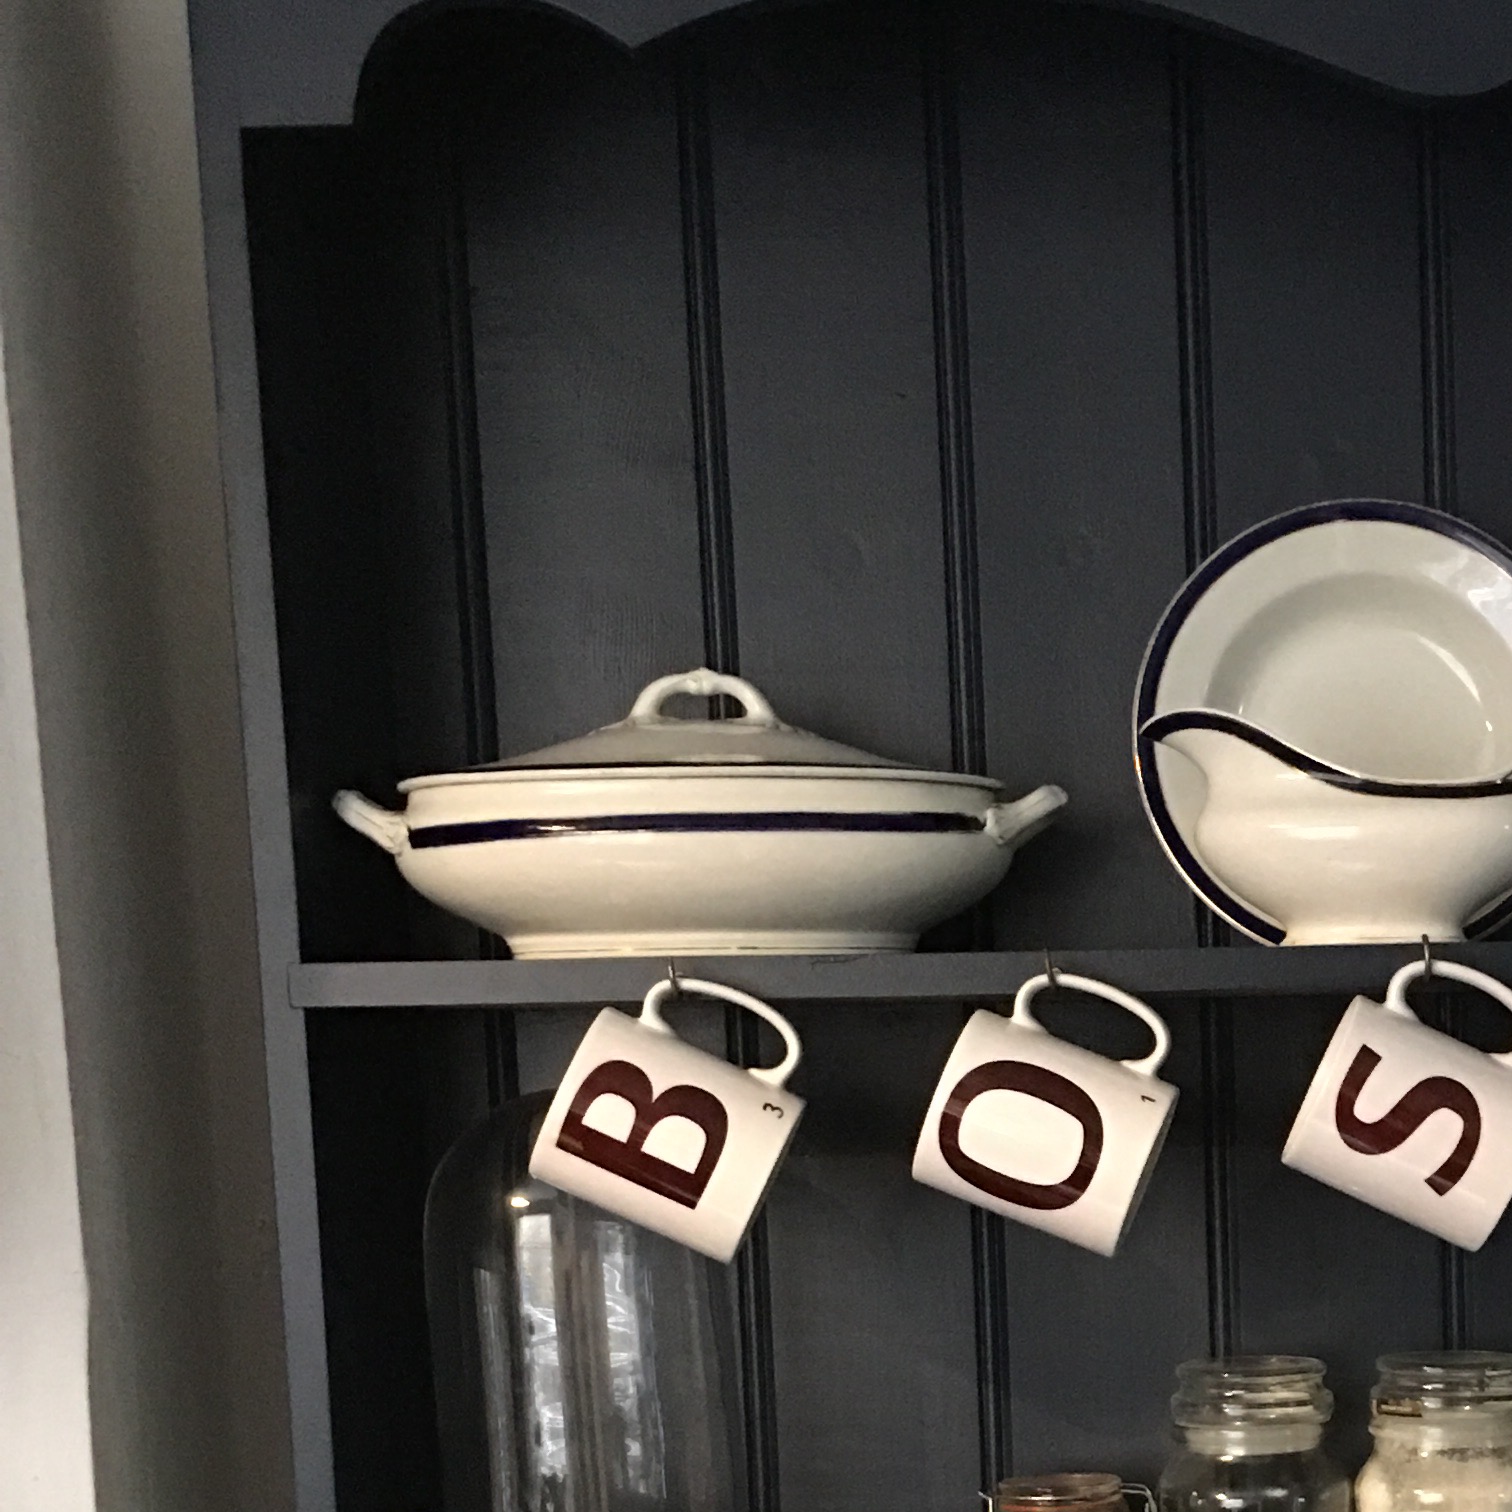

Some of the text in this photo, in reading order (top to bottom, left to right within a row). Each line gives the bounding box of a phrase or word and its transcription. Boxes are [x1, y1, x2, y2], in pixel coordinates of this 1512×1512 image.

[556, 1059, 728, 1209] B
[763, 1101, 785, 1119] 3
[939, 1060, 1104, 1210] O
[1140, 1094, 1156, 1104] 1
[1335, 1043, 1482, 1197] S
